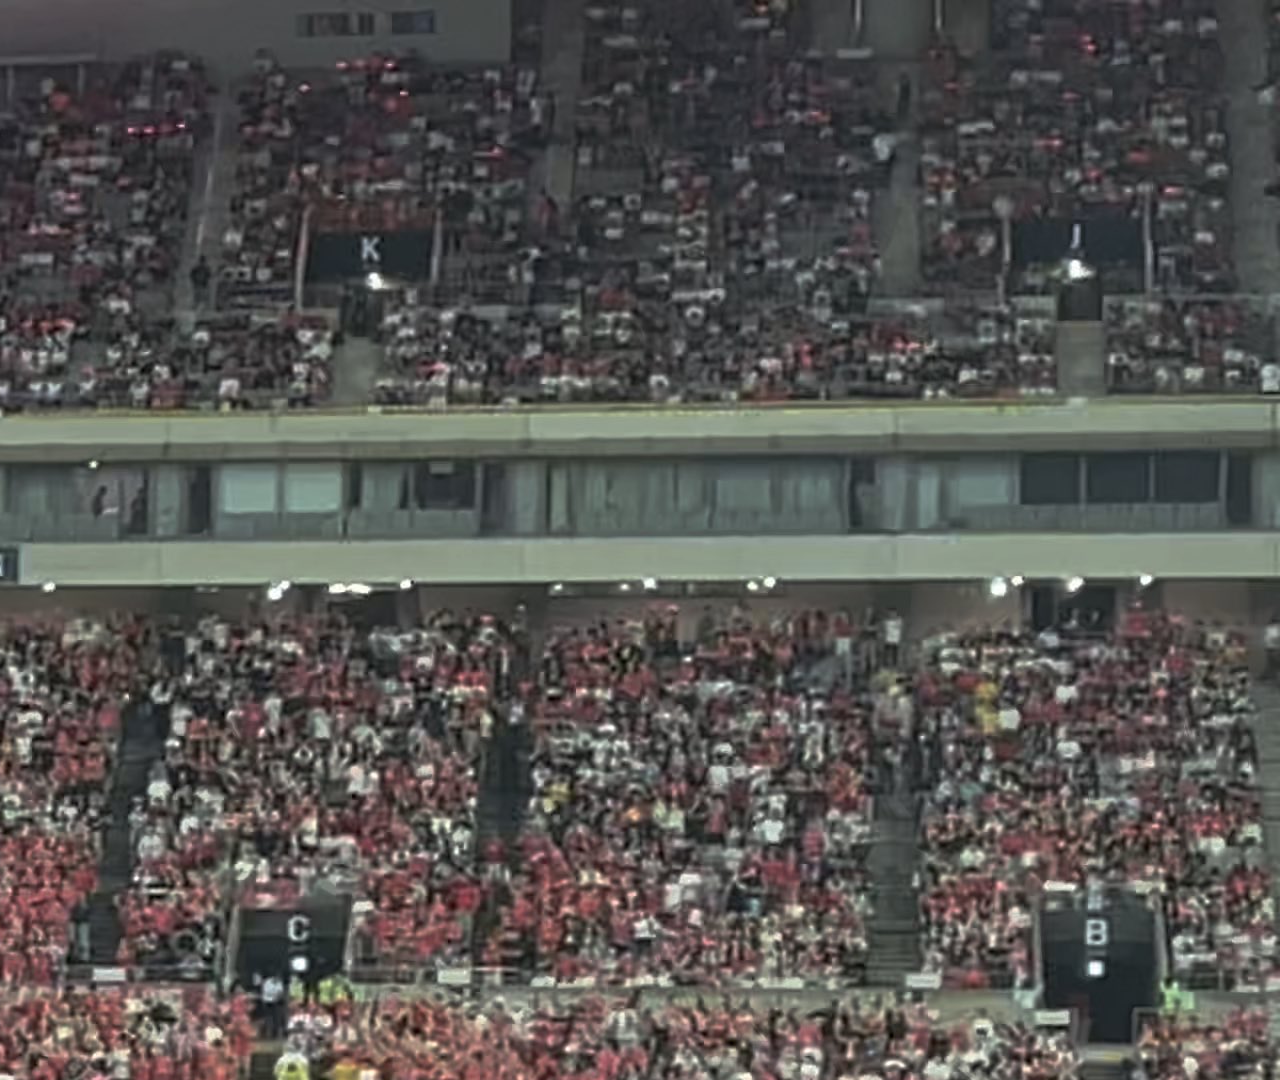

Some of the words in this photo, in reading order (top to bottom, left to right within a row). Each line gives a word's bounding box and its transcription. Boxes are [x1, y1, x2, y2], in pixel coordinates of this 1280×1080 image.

[1070, 224, 1082, 248] J
[362, 238, 380, 261] K
[288, 916, 310, 941] C
[1086, 919, 1108, 945] B
